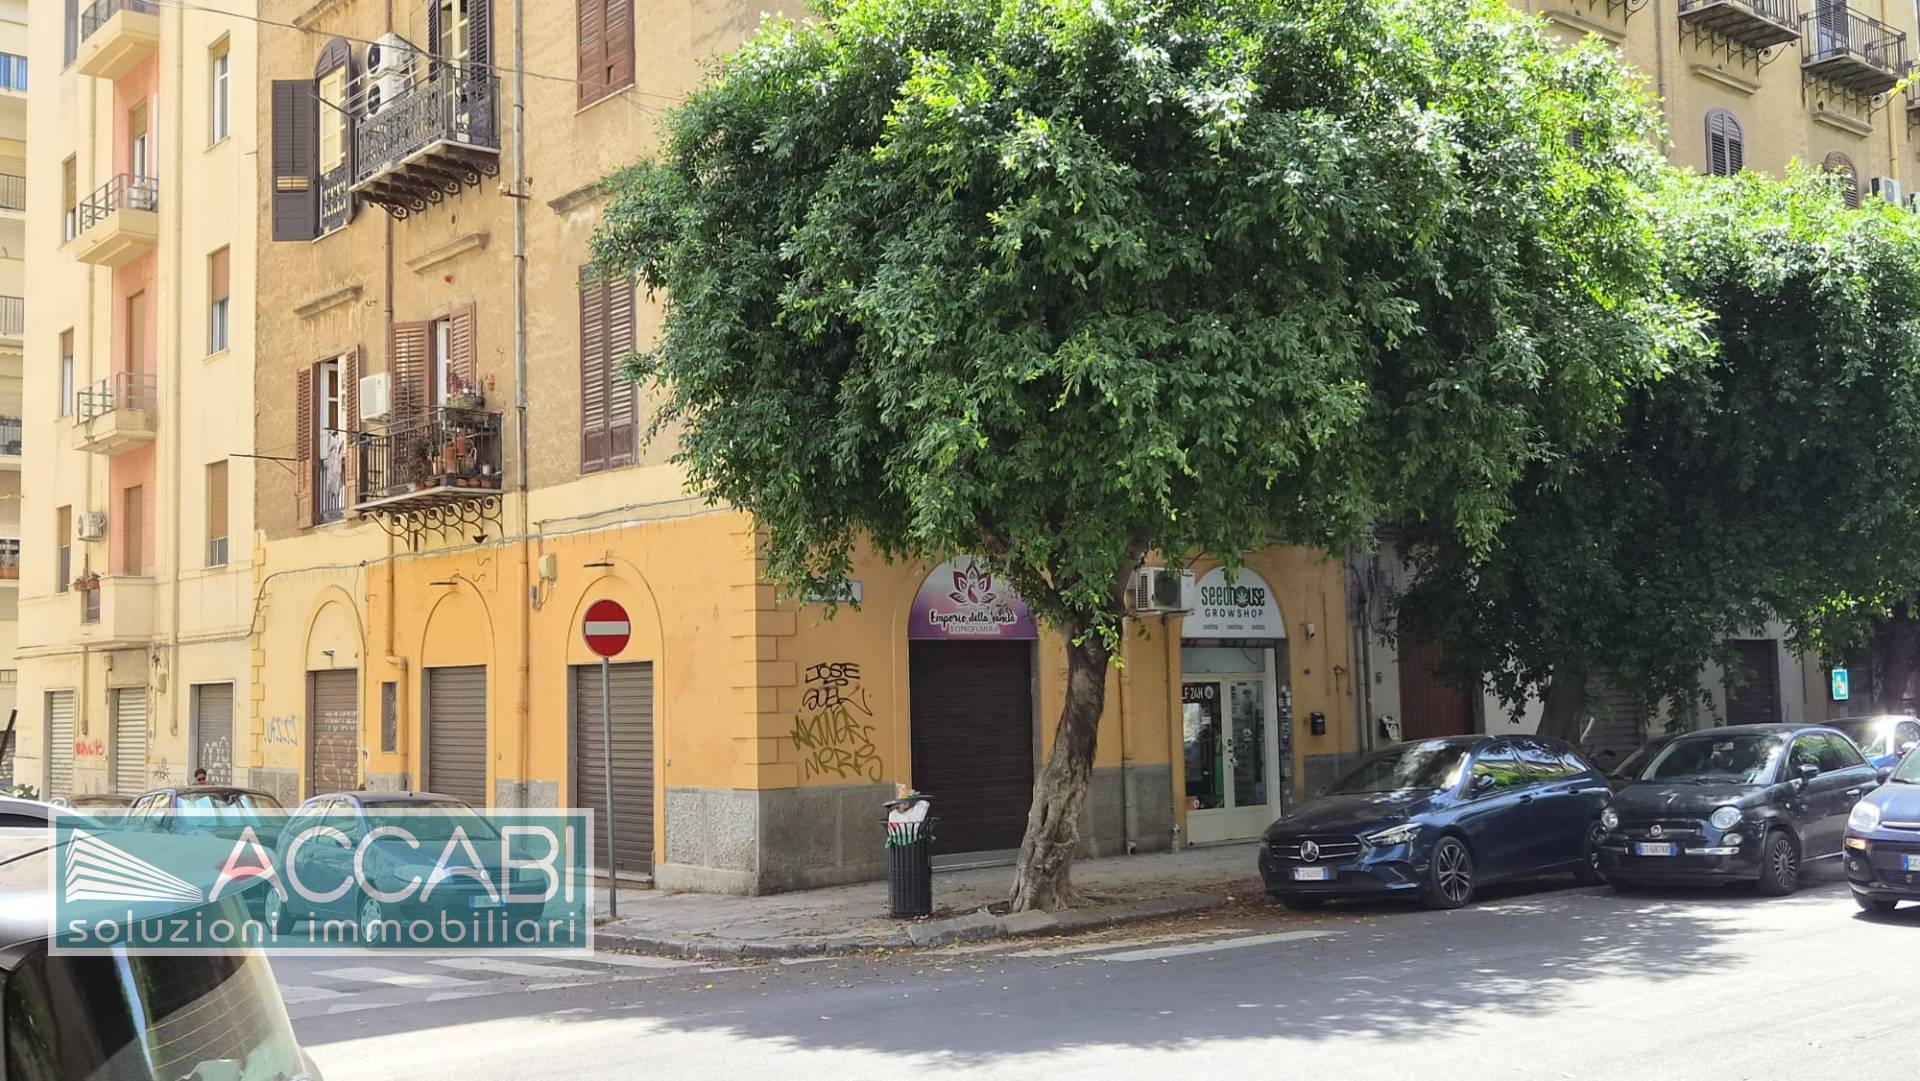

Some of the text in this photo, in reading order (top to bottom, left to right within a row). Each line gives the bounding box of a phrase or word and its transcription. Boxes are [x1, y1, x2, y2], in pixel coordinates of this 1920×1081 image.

[930, 609, 967, 629] Emporio
[969, 611, 989, 623] della
[1204, 608, 1264, 618] GROWSHOP
